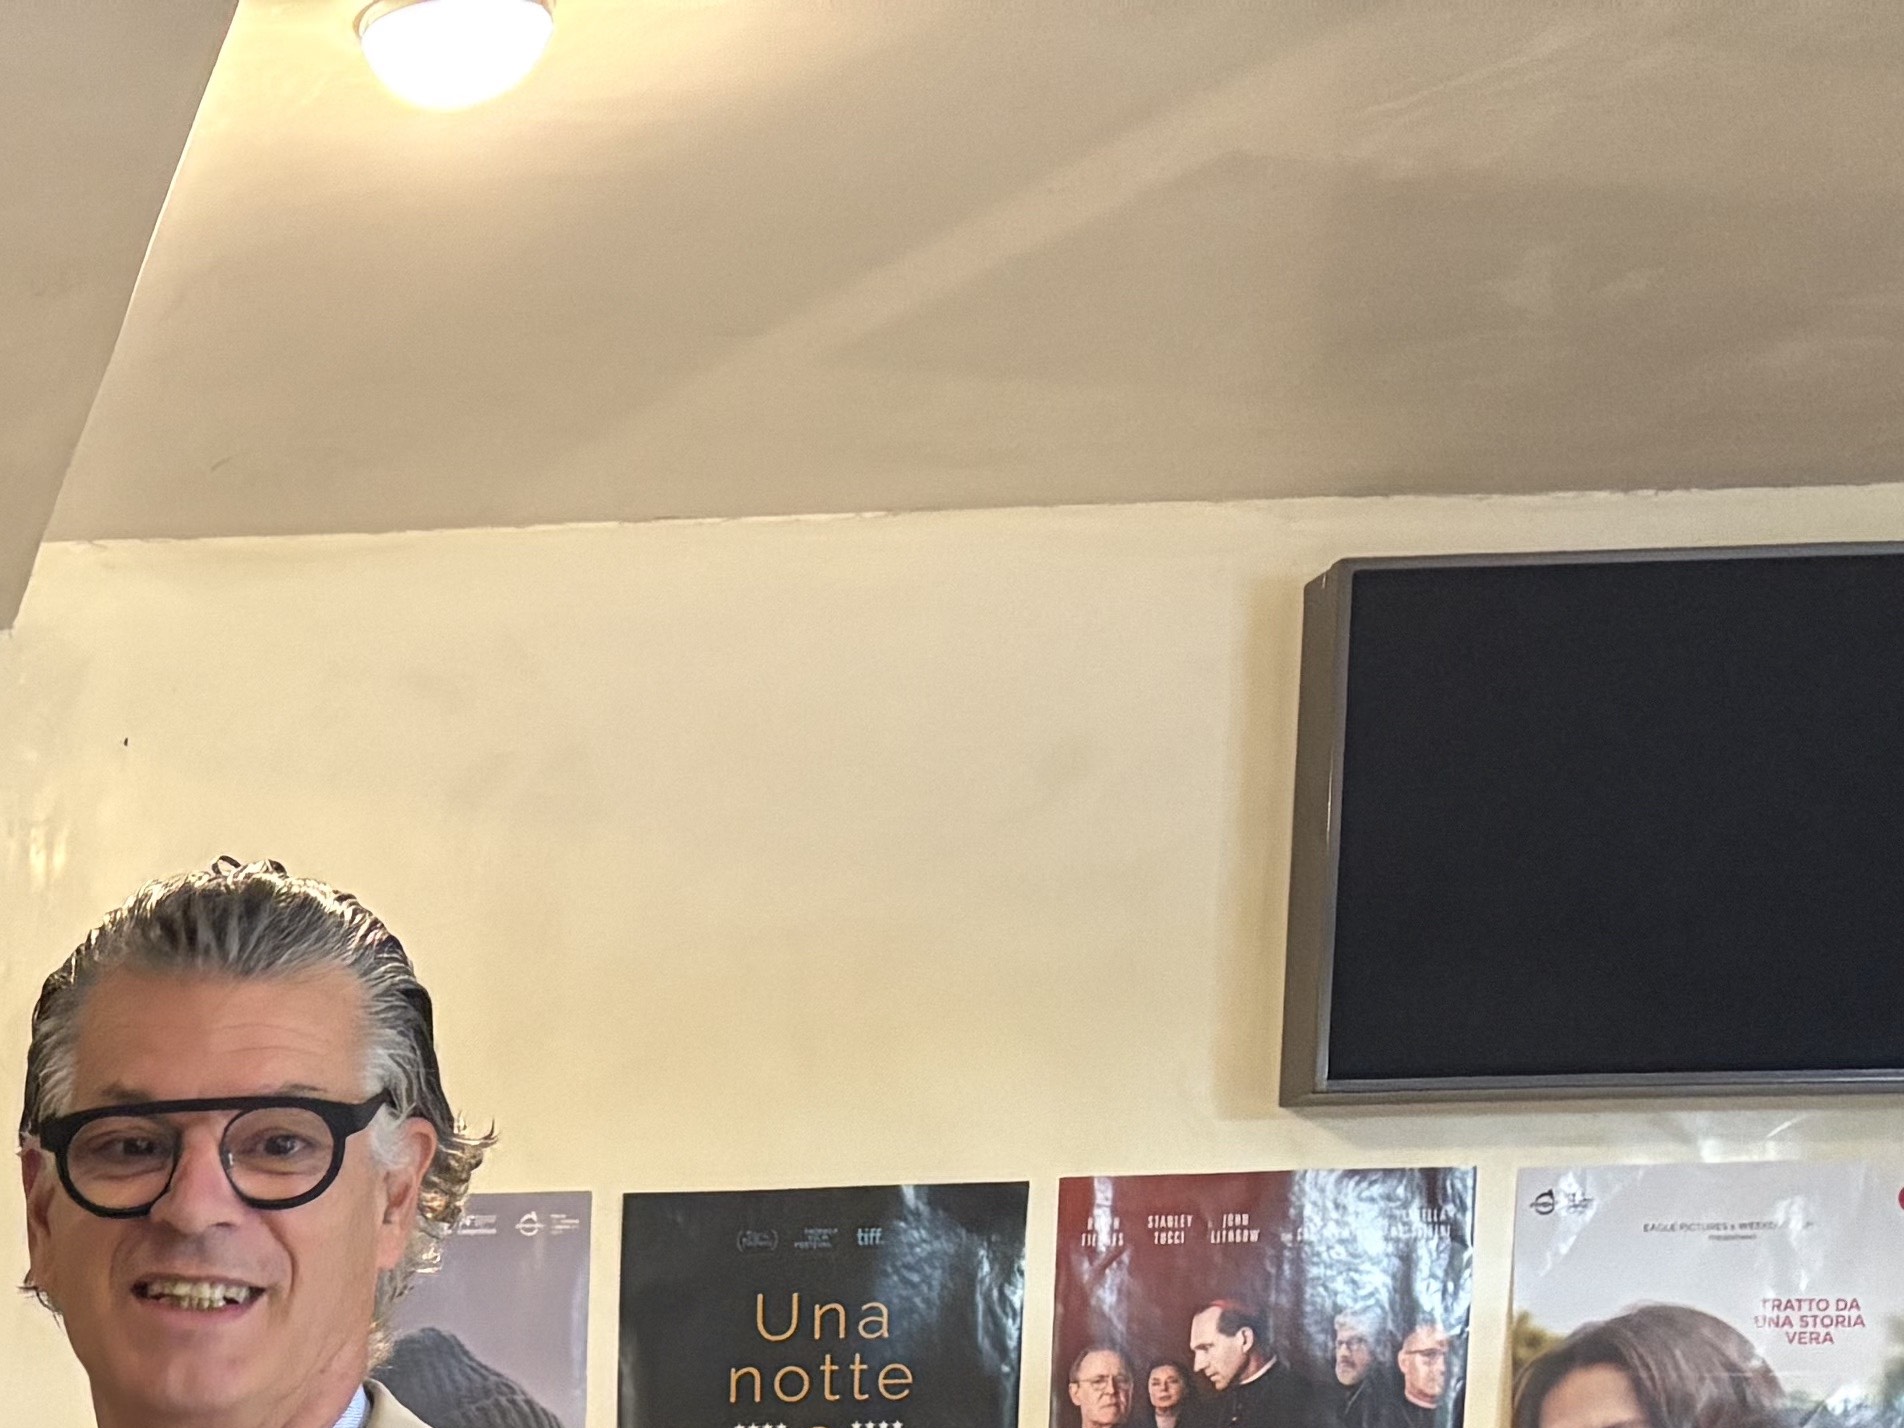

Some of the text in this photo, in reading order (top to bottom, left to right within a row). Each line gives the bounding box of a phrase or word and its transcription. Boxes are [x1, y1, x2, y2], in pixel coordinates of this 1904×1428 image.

[1760, 1297, 1861, 1313] TRATTO DA
[757, 1292, 889, 1342] Una
[1754, 1315, 1865, 1329] UNA STORIA
[1784, 1330, 1835, 1345] VERA
[729, 1354, 914, 1405] notte
